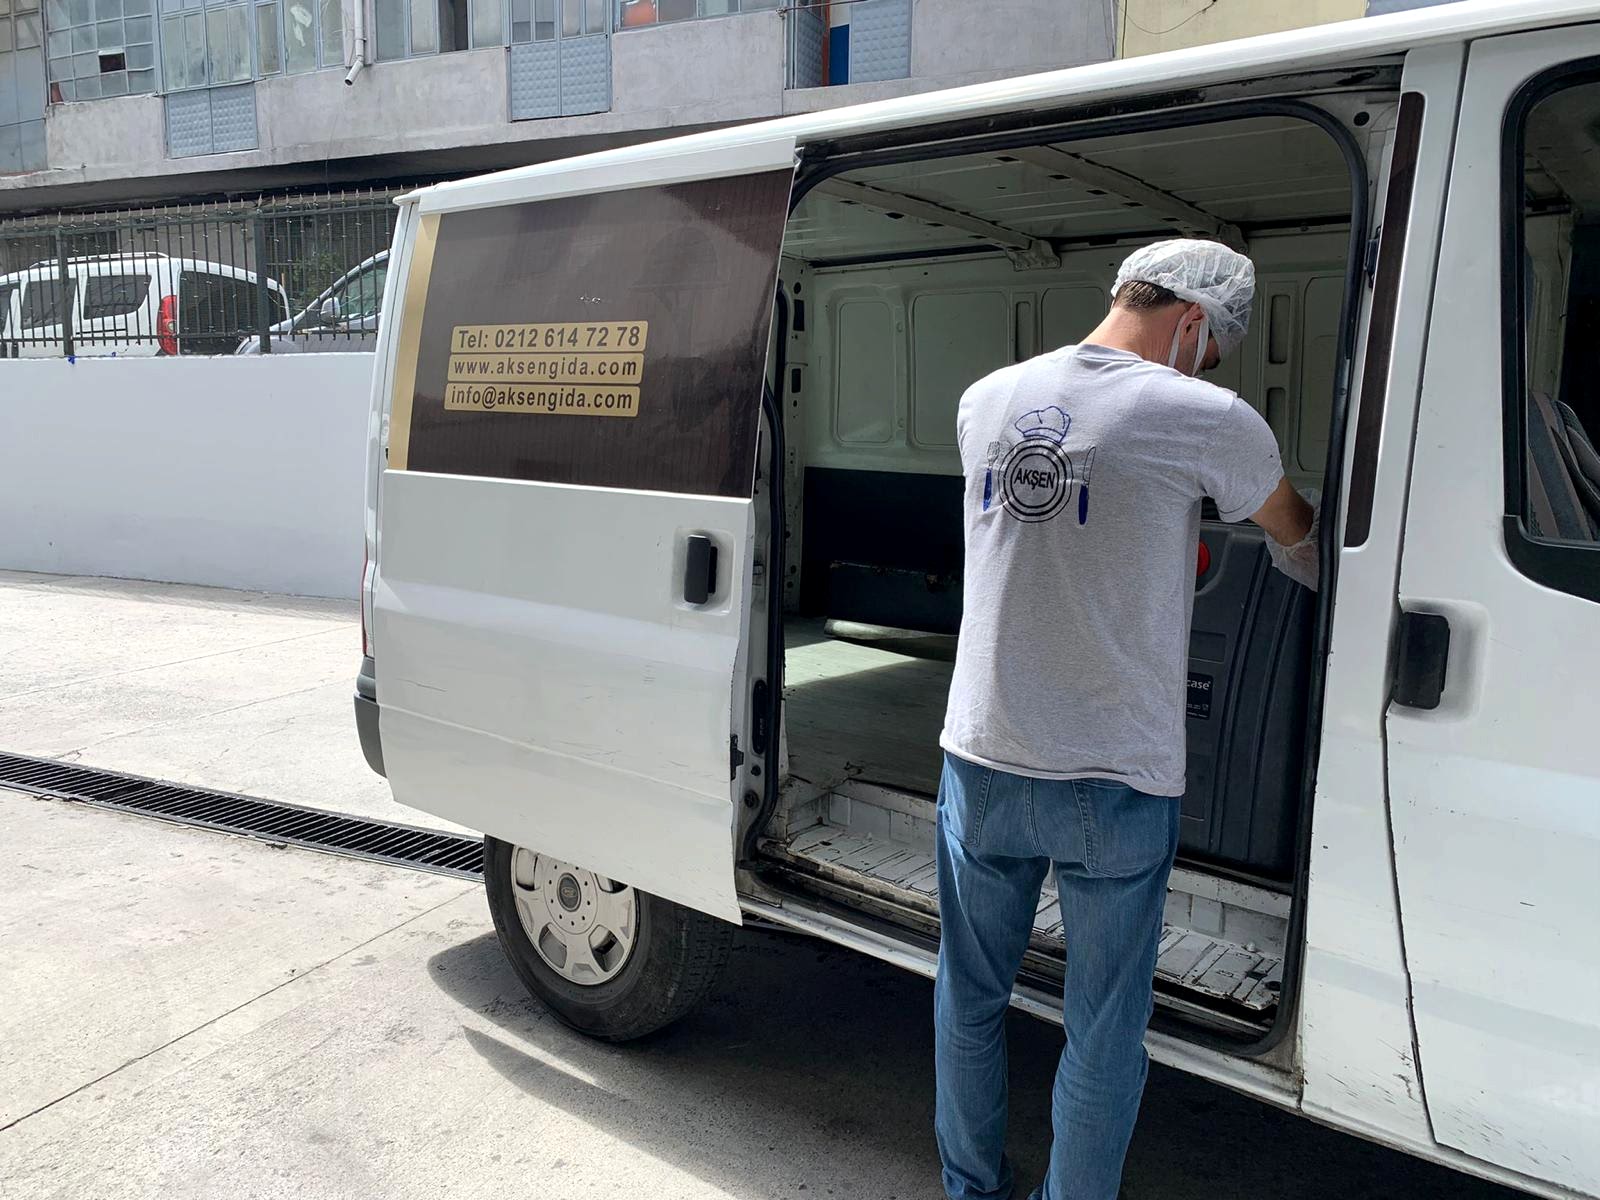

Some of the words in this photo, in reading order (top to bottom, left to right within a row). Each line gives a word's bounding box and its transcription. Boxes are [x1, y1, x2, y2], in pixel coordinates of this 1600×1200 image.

[458, 329, 488, 349] Tel:
[495, 328, 539, 348] 0212
[544, 327, 579, 348] 614
[586, 326, 609, 347] 72
[617, 325, 640, 347] 78
[454, 356, 637, 380] www.aksengida.com
[450, 385, 633, 412] info@aksengida.com
[1013, 467, 1056, 491] AKŞEN
